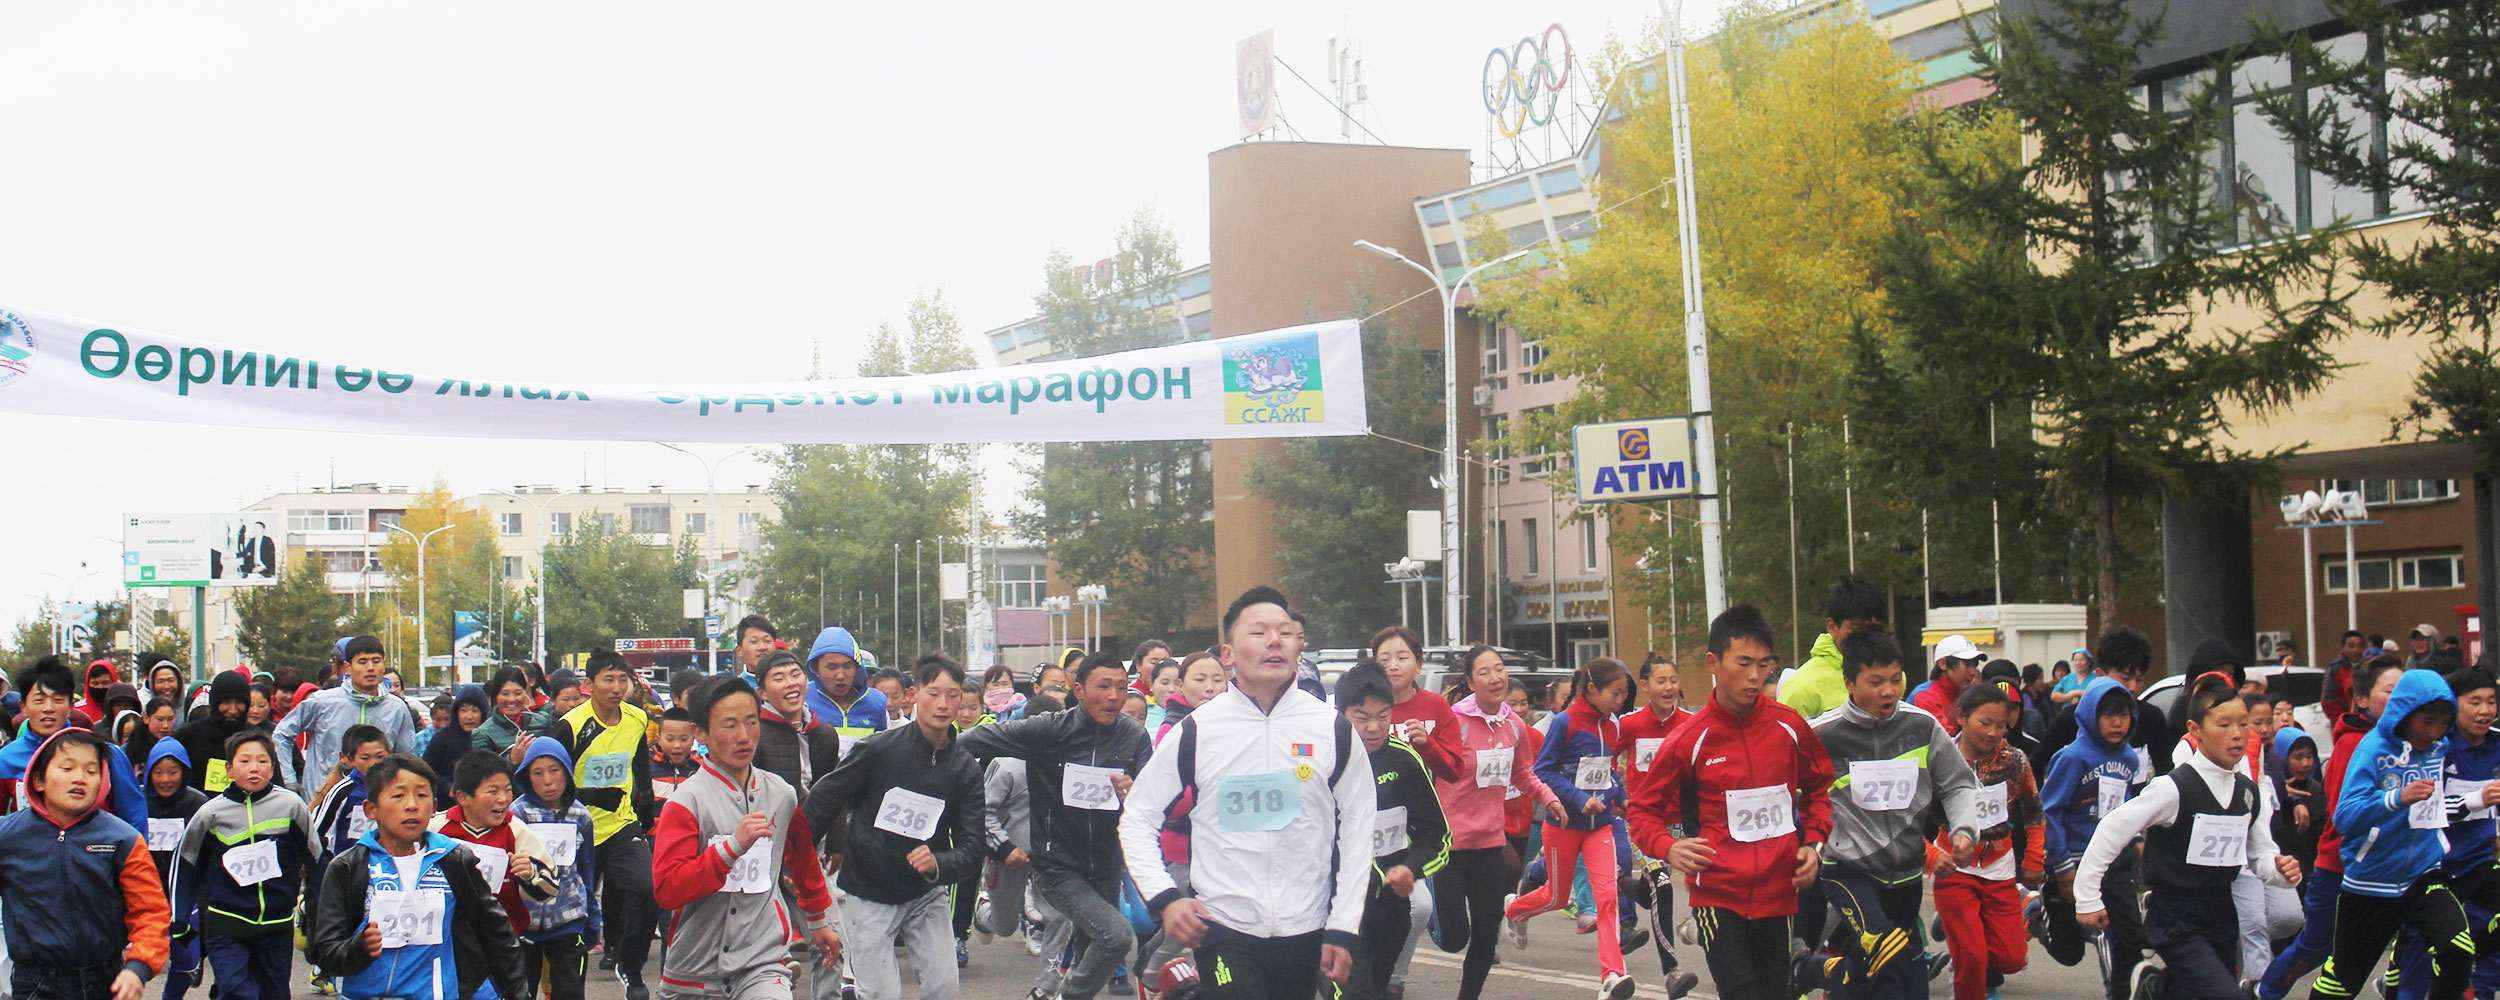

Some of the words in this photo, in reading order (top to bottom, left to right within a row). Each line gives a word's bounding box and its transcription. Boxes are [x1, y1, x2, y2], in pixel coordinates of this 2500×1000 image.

[1241, 407, 1311, 423] ССАЖГ
[1593, 461, 1686, 494] ATM
[591, 763, 624, 781] 303
[1584, 769, 1609, 784] 497
[1070, 782, 1114, 803] 223
[1225, 789, 1285, 815] 318
[1862, 779, 1911, 803] 279
[883, 803, 929, 831] 236
[1736, 804, 1784, 832] 260
[1976, 799, 2000, 820] 36
[353, 817, 377, 833] 27
[148, 831, 180, 846] 271
[1373, 825, 1400, 850] 87
[2199, 835, 2243, 859] 277
[230, 856, 270, 879] 270
[729, 857, 760, 883] 96
[382, 911, 435, 938] 291
